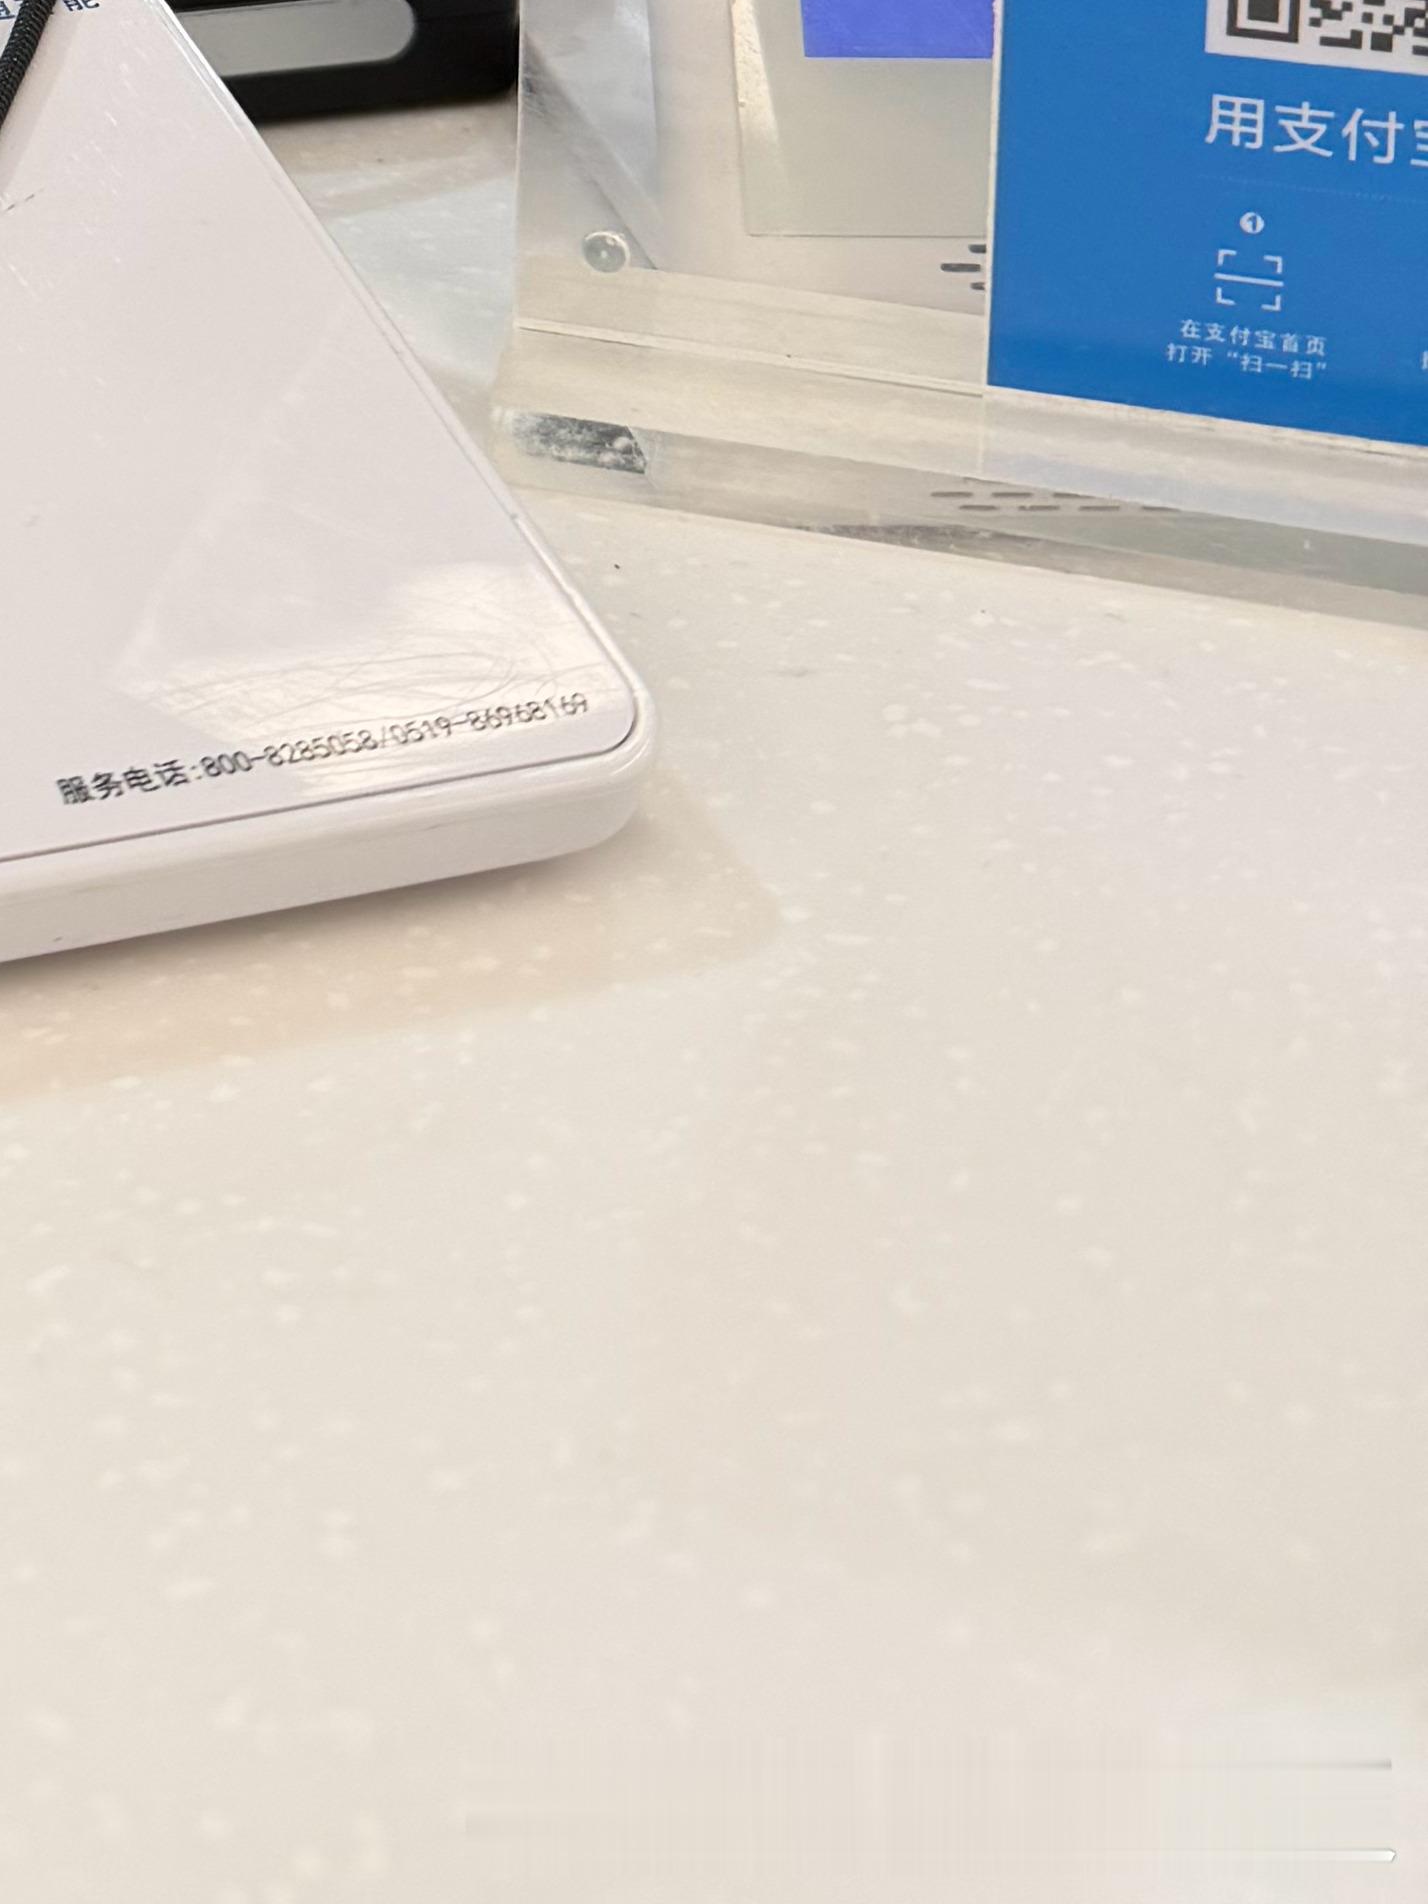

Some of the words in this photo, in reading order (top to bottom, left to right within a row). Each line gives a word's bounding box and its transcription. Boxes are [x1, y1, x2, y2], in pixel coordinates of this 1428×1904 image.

[1179, 318, 1328, 357] 在支付宝首页
